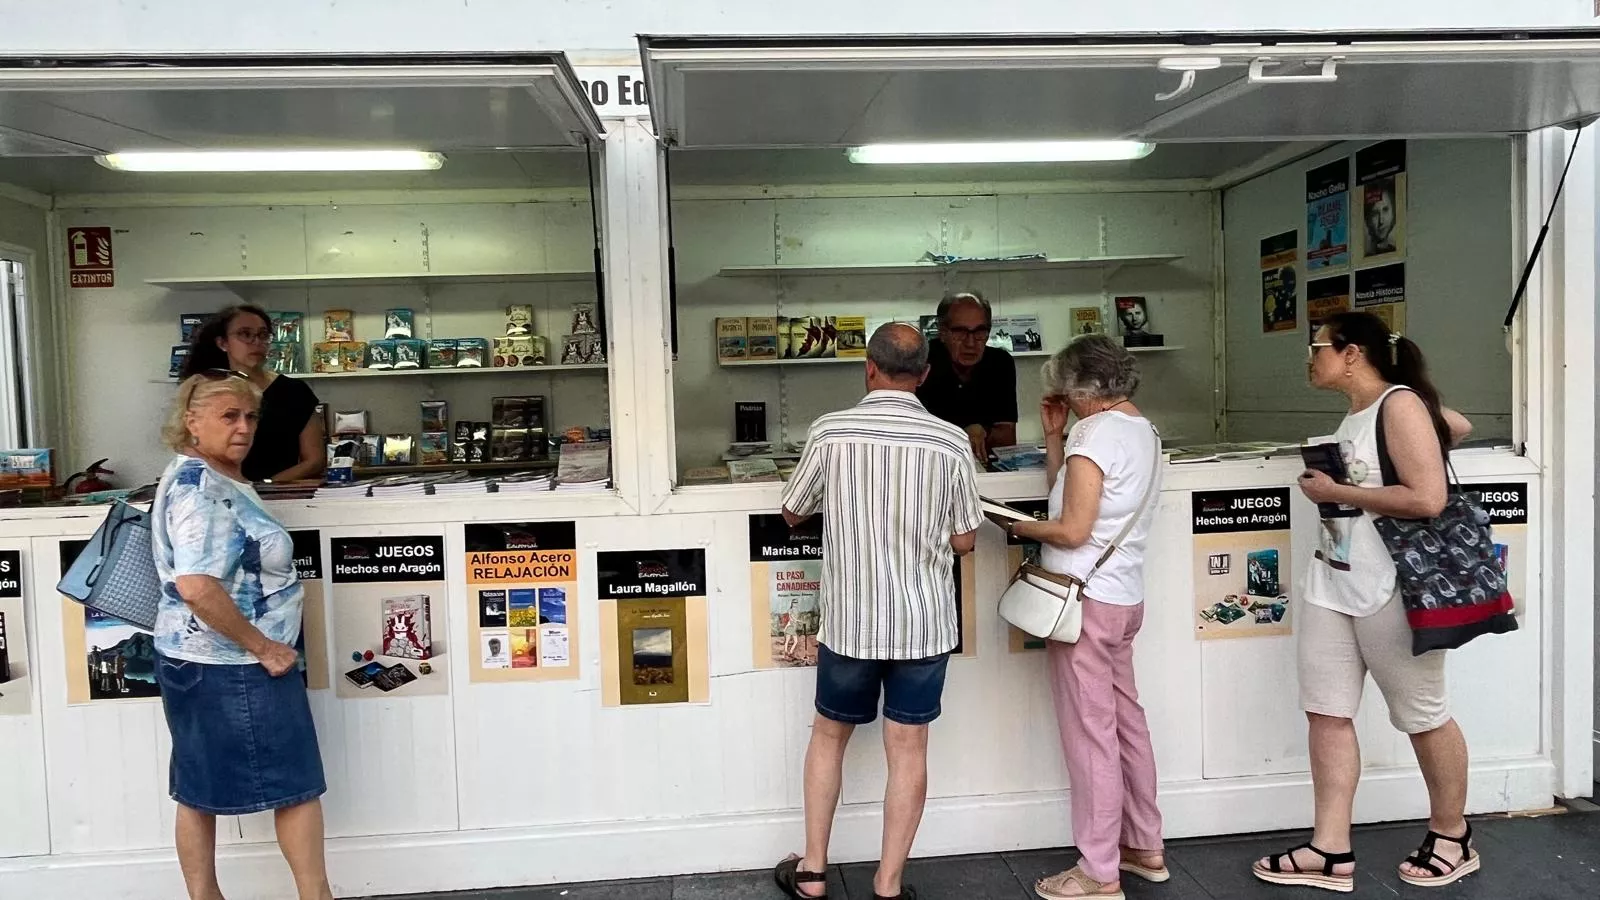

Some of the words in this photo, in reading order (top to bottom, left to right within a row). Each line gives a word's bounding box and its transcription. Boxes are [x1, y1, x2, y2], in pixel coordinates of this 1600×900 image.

[72, 273, 112, 284] EXTINTOR
[1230, 497, 1281, 509] JUEGOS
[1196, 515, 1234, 525] Hechos
[1236, 516, 1249, 524] en
[1251, 512, 1287, 524] Aragón
[1489, 507, 1525, 519] Aragón
[375, 545, 435, 558] JUEGOS
[762, 546, 799, 556] Marisa
[471, 553, 526, 565] Alfonso
[530, 552, 571, 563] Acero
[336, 564, 379, 574] Hechos
[382, 565, 396, 573] en
[399, 562, 441, 575] Aragón
[474, 564, 569, 579] RELAJACIÓN
[777, 571, 786, 580] EL
[787, 570, 804, 580] PASO
[609, 584, 642, 594] Laura
[645, 581, 696, 594] Magallón
[776, 581, 821, 591] CANADIENSE
